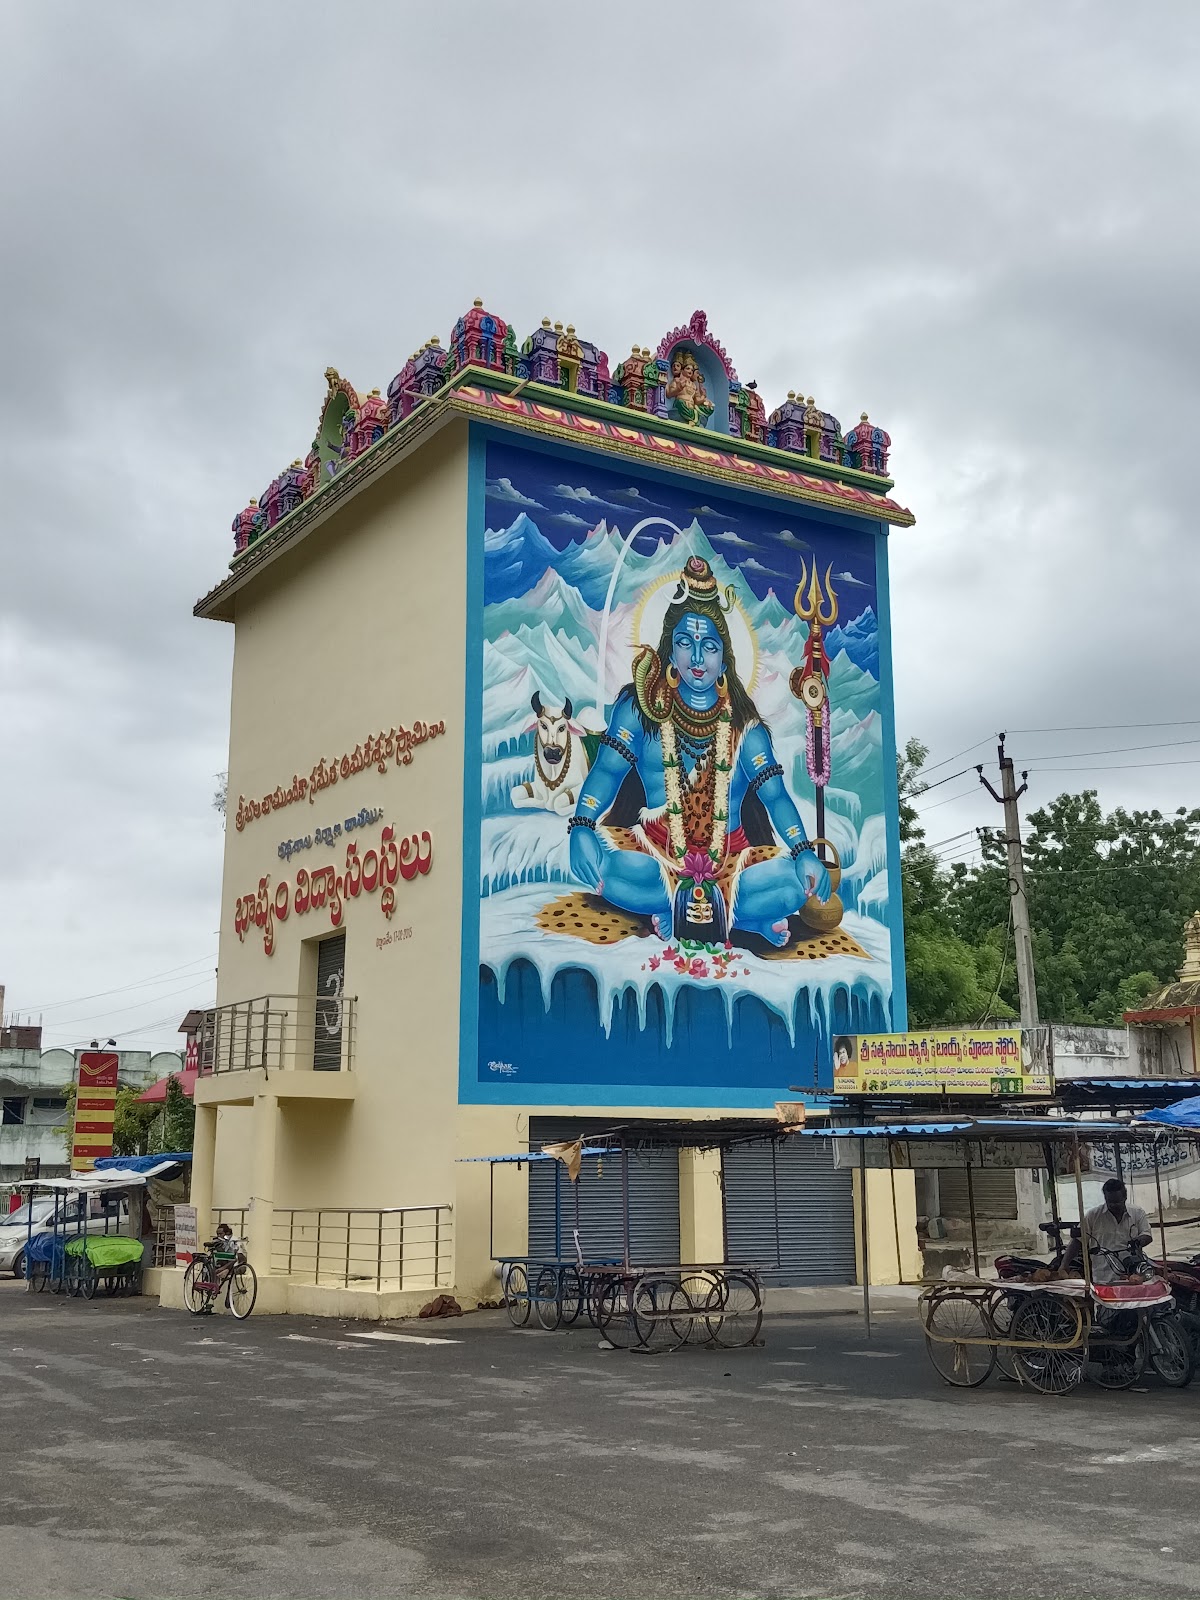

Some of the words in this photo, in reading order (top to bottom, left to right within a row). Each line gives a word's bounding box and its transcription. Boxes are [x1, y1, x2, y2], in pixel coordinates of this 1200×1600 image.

[234, 873, 291, 957] భాష్యం
[861, 1039, 870, 1062] శ్రీ
[968, 1038, 993, 1060] పూజా
